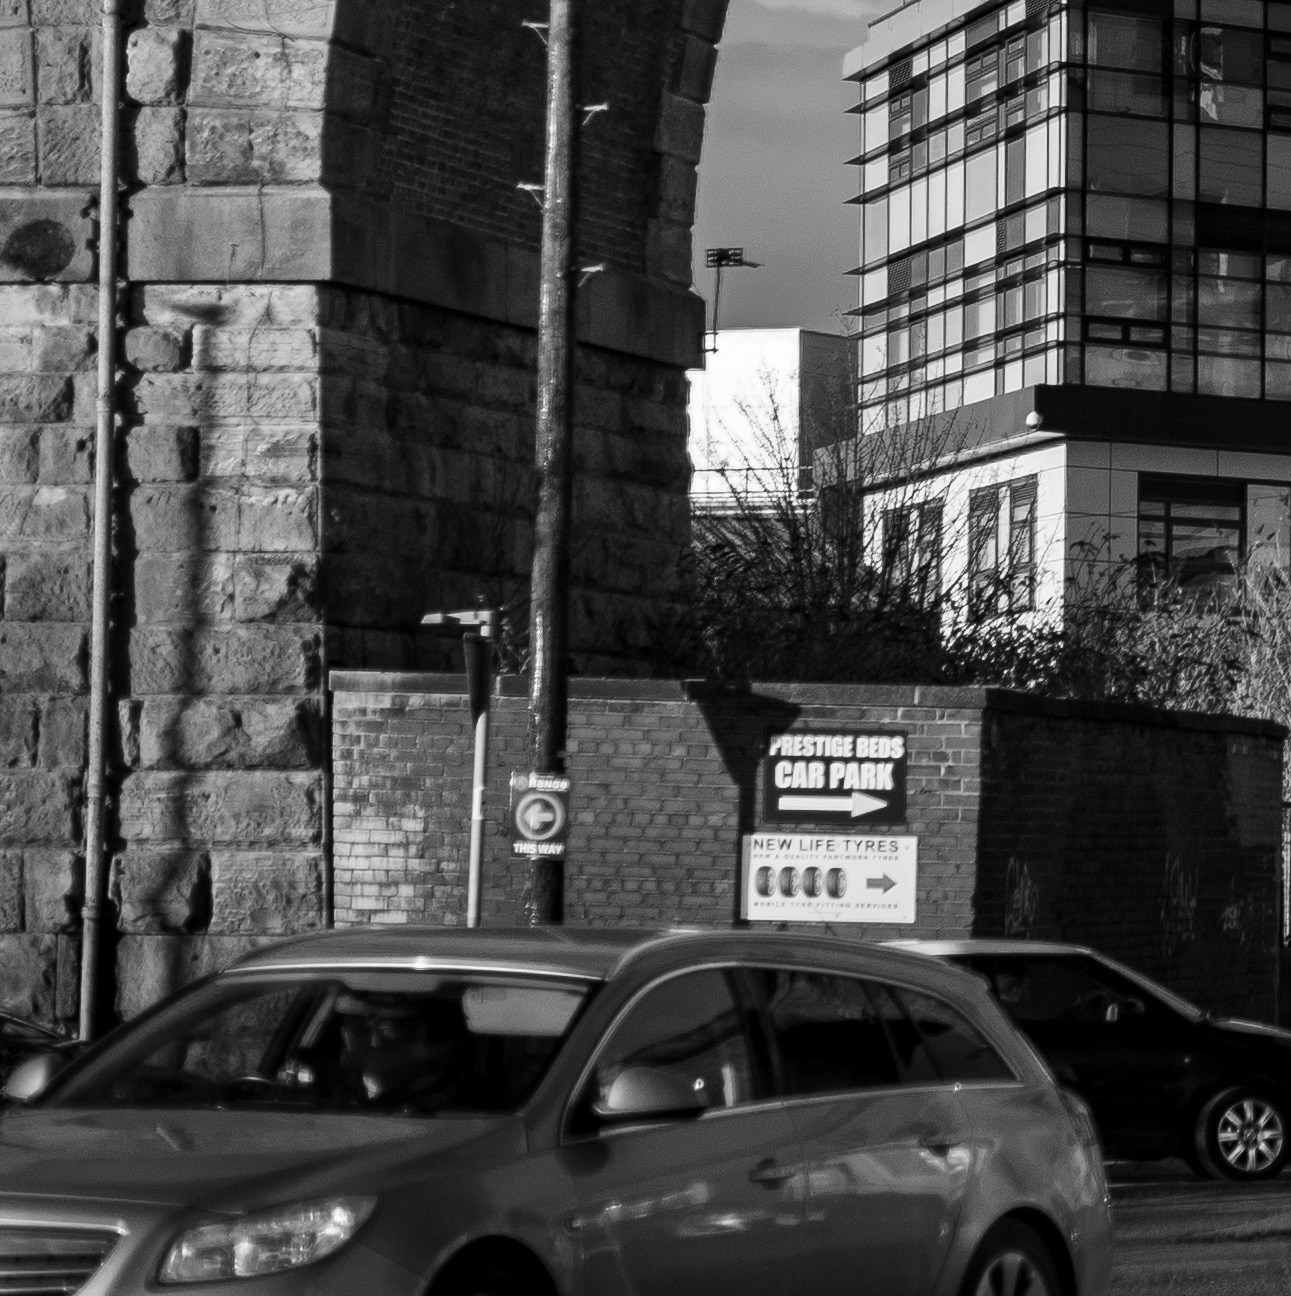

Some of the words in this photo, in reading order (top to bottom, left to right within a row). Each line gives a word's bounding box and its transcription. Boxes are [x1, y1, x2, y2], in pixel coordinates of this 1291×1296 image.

[769, 734, 854, 757] PRESTIGE
[855, 734, 906, 760] BEDS
[774, 760, 826, 789] CAR
[828, 761, 895, 791] PARK
[513, 842, 537, 854] THIS
[538, 843, 564, 855] WAY
[753, 838, 793, 852] NEW
[799, 838, 836, 853] LIFE
[842, 839, 900, 854] TYRES
